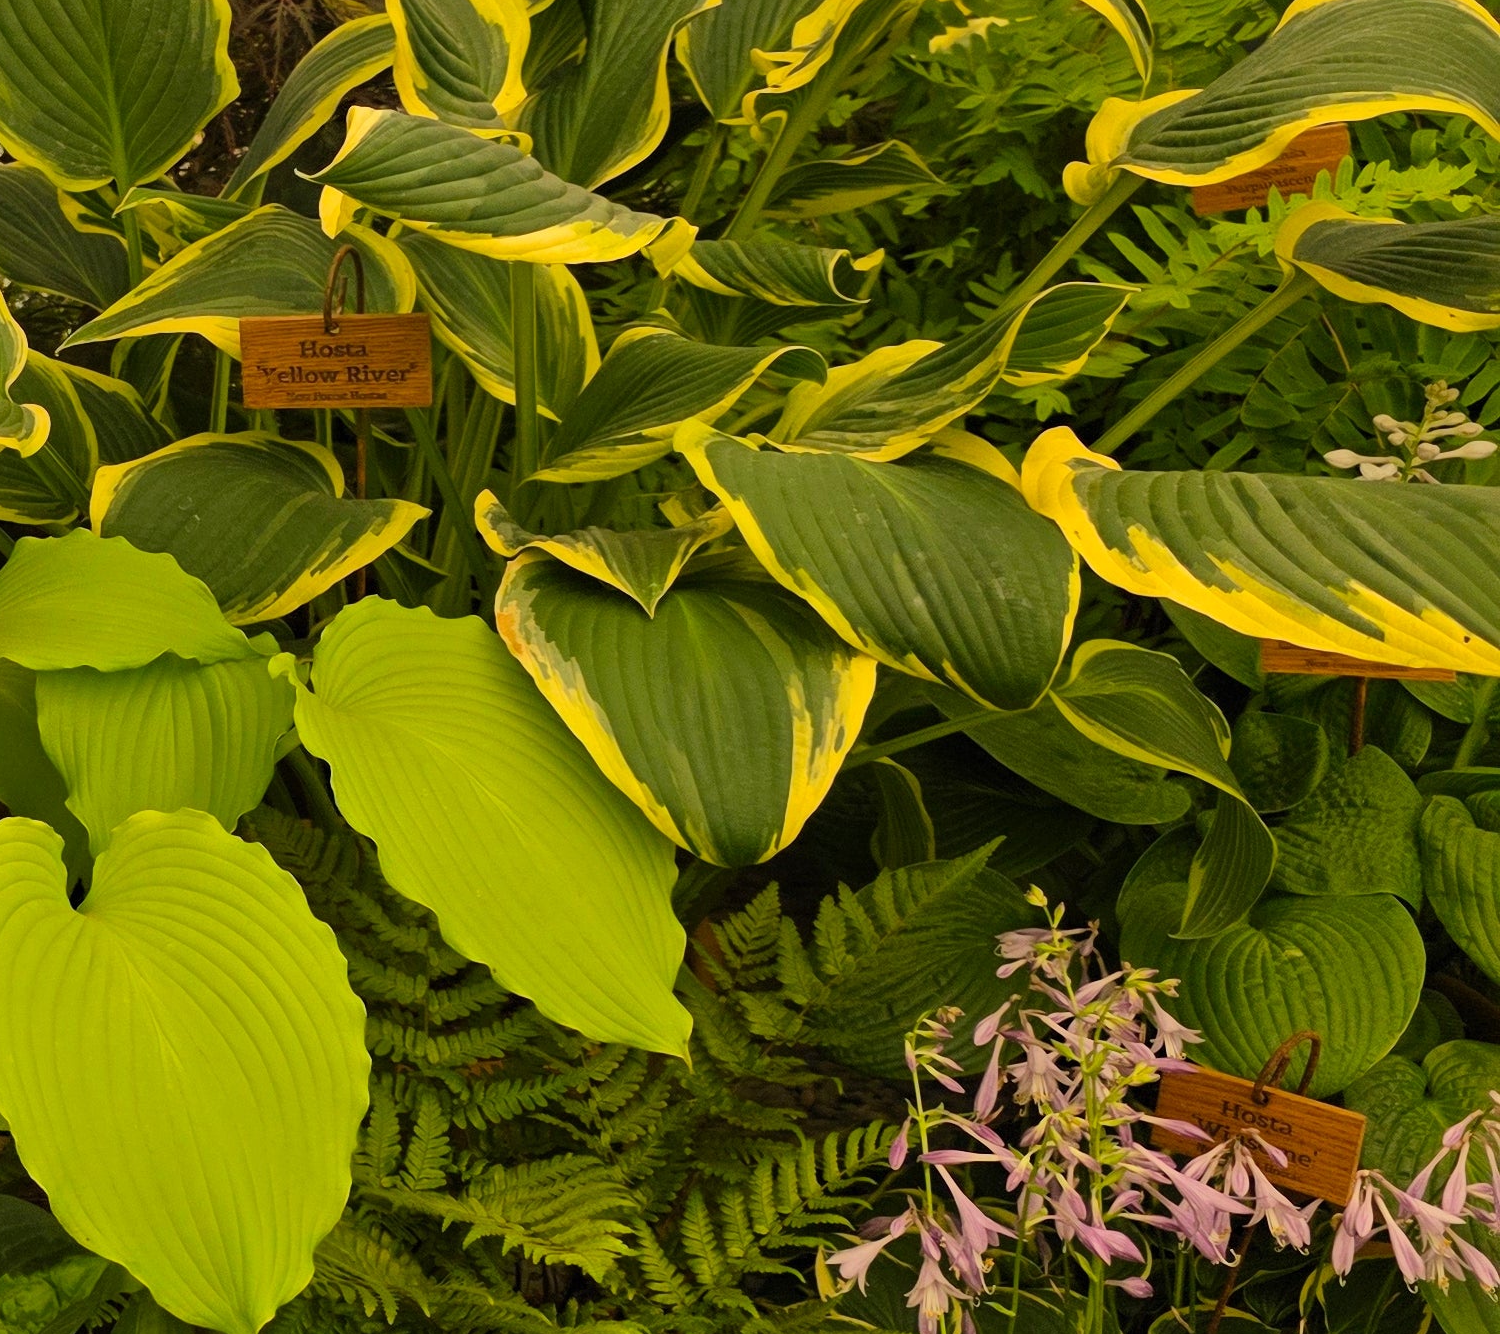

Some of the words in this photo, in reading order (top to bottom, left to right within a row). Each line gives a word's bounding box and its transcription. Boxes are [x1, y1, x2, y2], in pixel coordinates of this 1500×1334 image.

[299, 340, 369, 358] Hosta
[257, 365, 340, 384] 'Yellow
[347, 362, 418, 384] River'
[1221, 1100, 1293, 1136] Hosta
